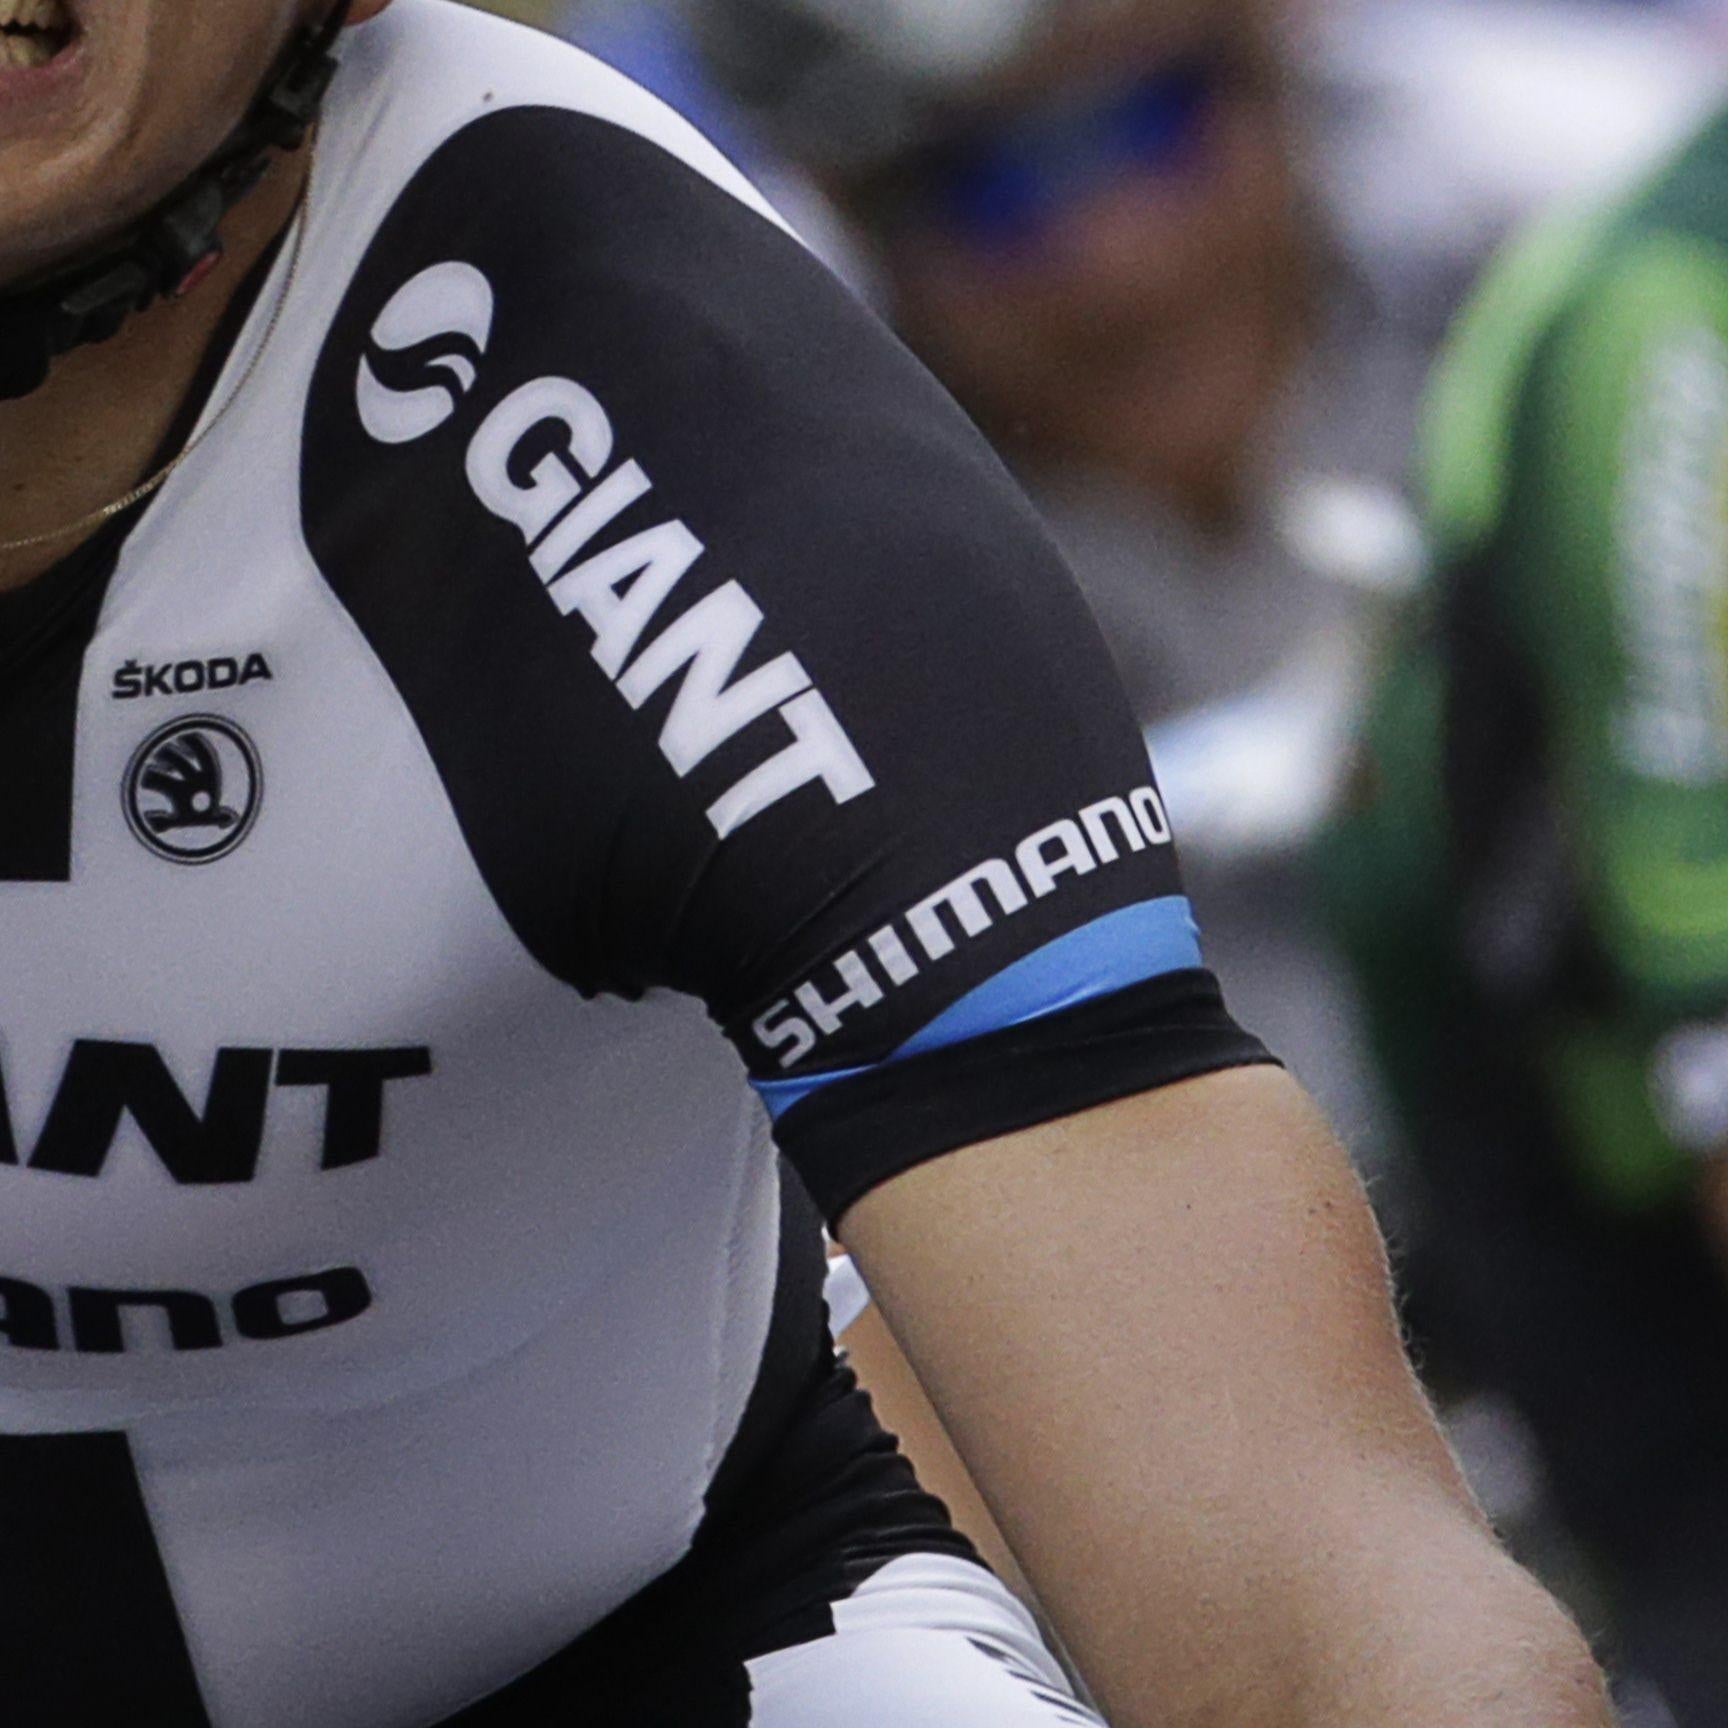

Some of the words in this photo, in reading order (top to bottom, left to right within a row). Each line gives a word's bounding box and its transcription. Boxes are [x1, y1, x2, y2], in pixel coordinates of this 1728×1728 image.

[111, 652, 274, 700] ŠKODA
[464, 375, 876, 840] GIANT
[751, 785, 1172, 1069] SHIMANO
